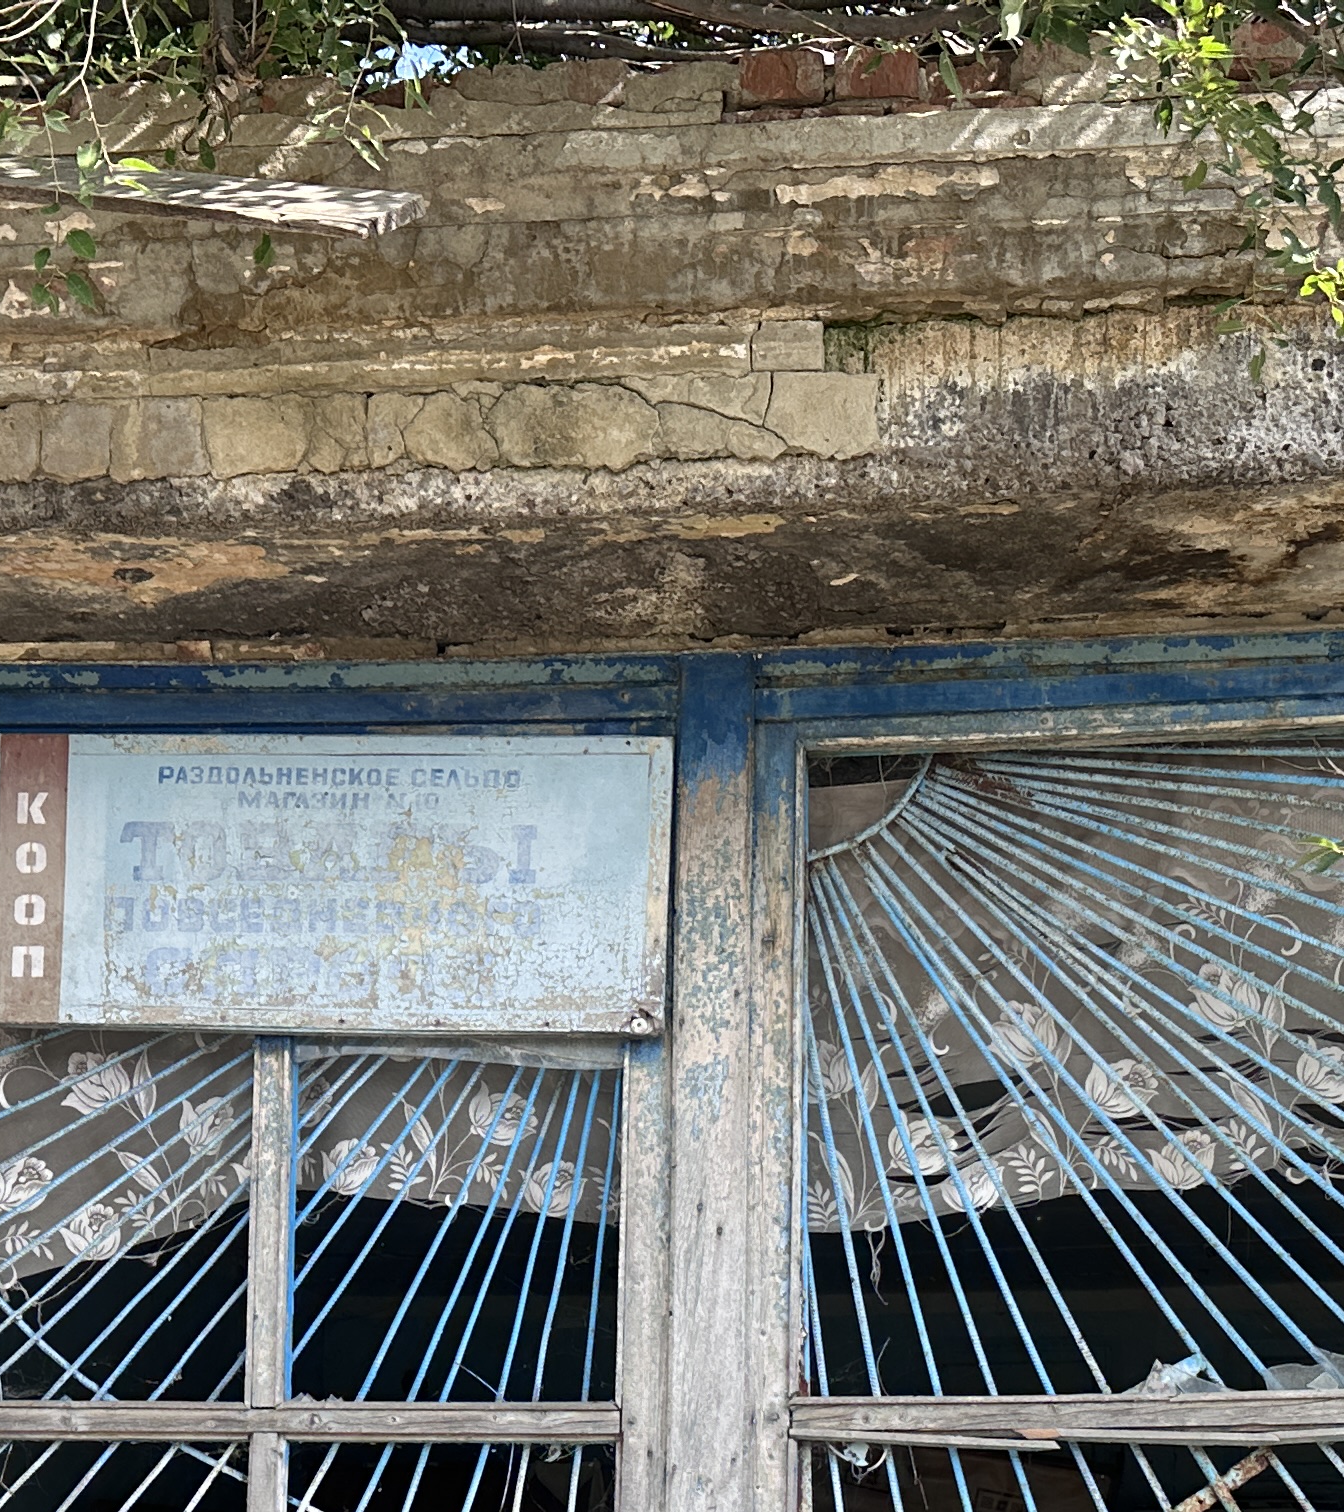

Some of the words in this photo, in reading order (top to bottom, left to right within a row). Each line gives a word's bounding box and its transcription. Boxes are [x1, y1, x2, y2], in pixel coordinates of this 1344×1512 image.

[157, 765, 401, 787] РАЗДОЛЬНЕНСКОЕ
[410, 767, 522, 789] СЕЛЬПО
[237, 790, 371, 810] МАГАЗИН
[11, 791, 49, 978] КООП
